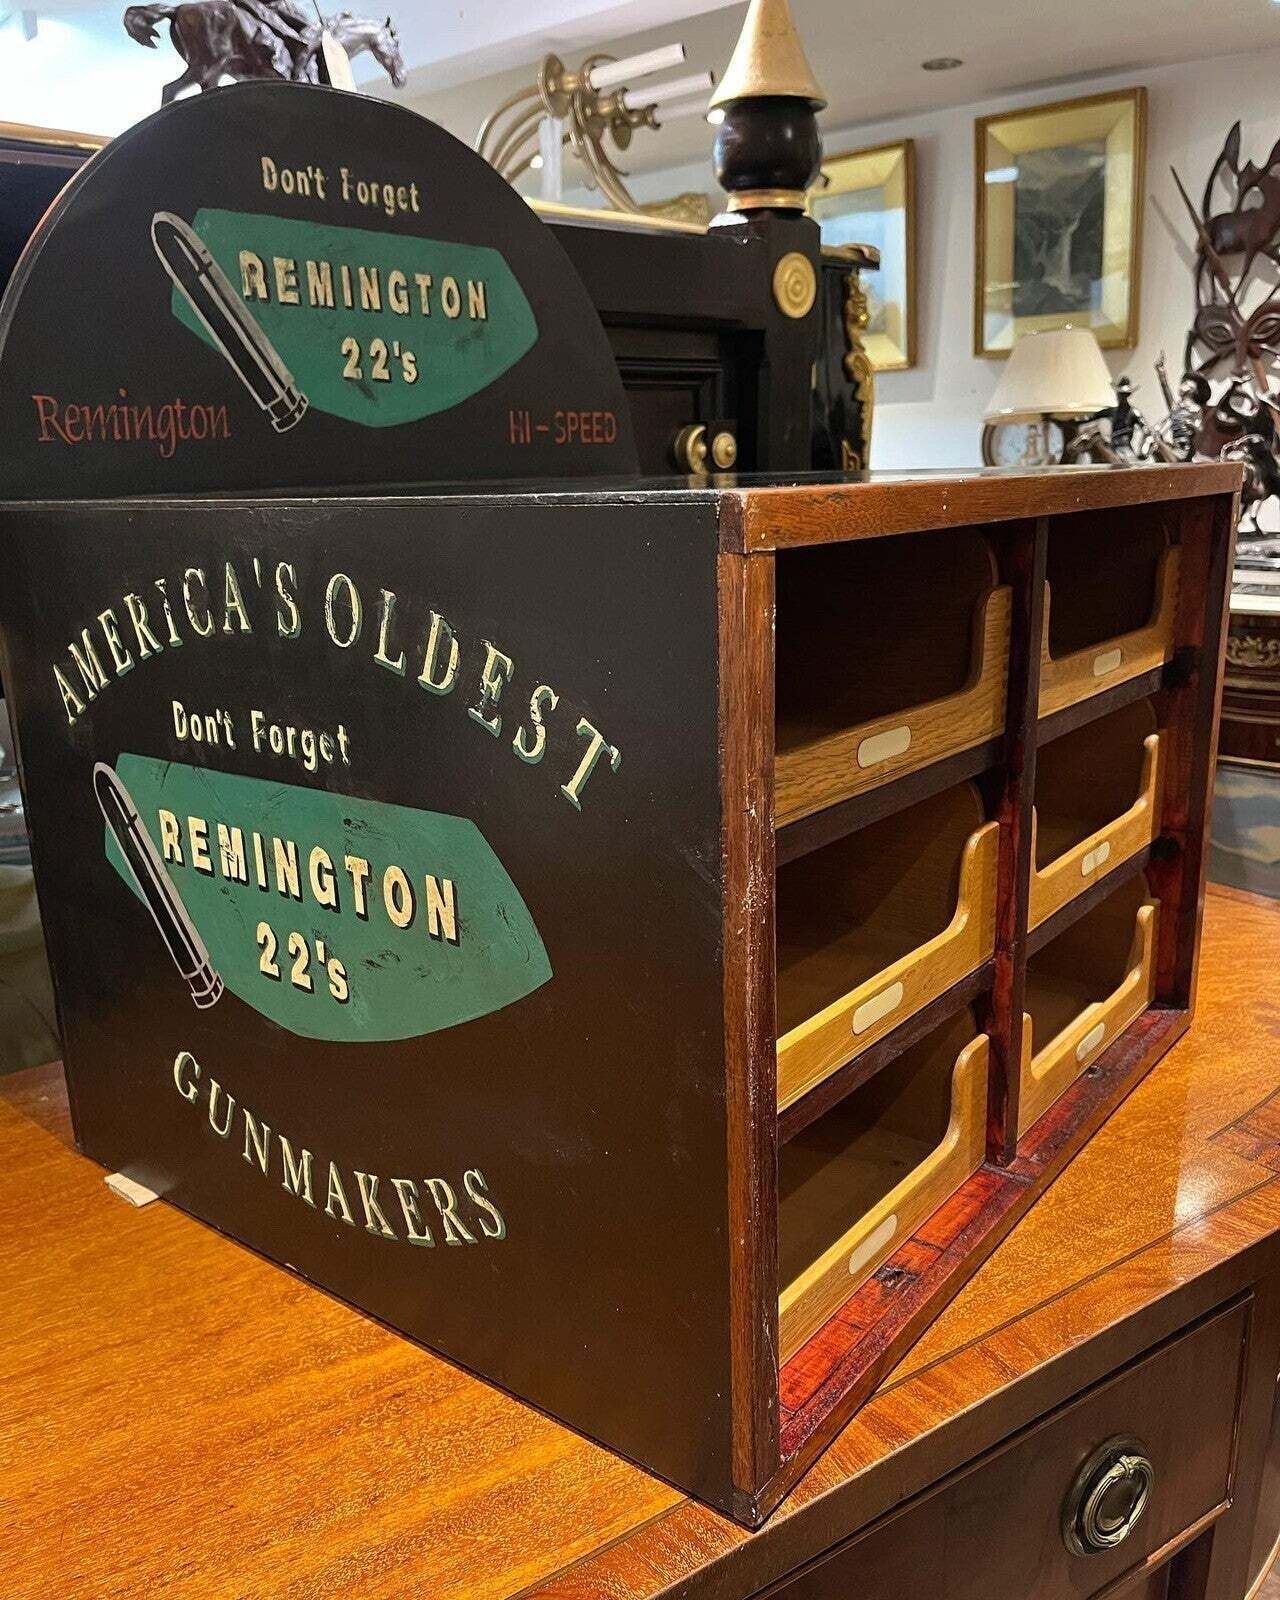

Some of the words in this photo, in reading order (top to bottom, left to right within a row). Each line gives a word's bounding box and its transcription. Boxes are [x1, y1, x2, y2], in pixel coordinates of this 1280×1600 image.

[260, 156, 325, 200] Don't
[341, 167, 421, 215] Forget
[237, 249, 490, 321] REMINGTON
[339, 337, 420, 385] 22's
[31, 388, 233, 459] Remington
[52, 557, 302, 727] AMERICA'S
[323, 572, 622, 813] OLDEST
[171, 700, 236, 750] Don't
[251, 709, 352, 774] Forget
[157, 809, 460, 947] REMINGTON
[256, 921, 350, 1005] 22's
[172, 1051, 507, 1249] GUNMAKERS
